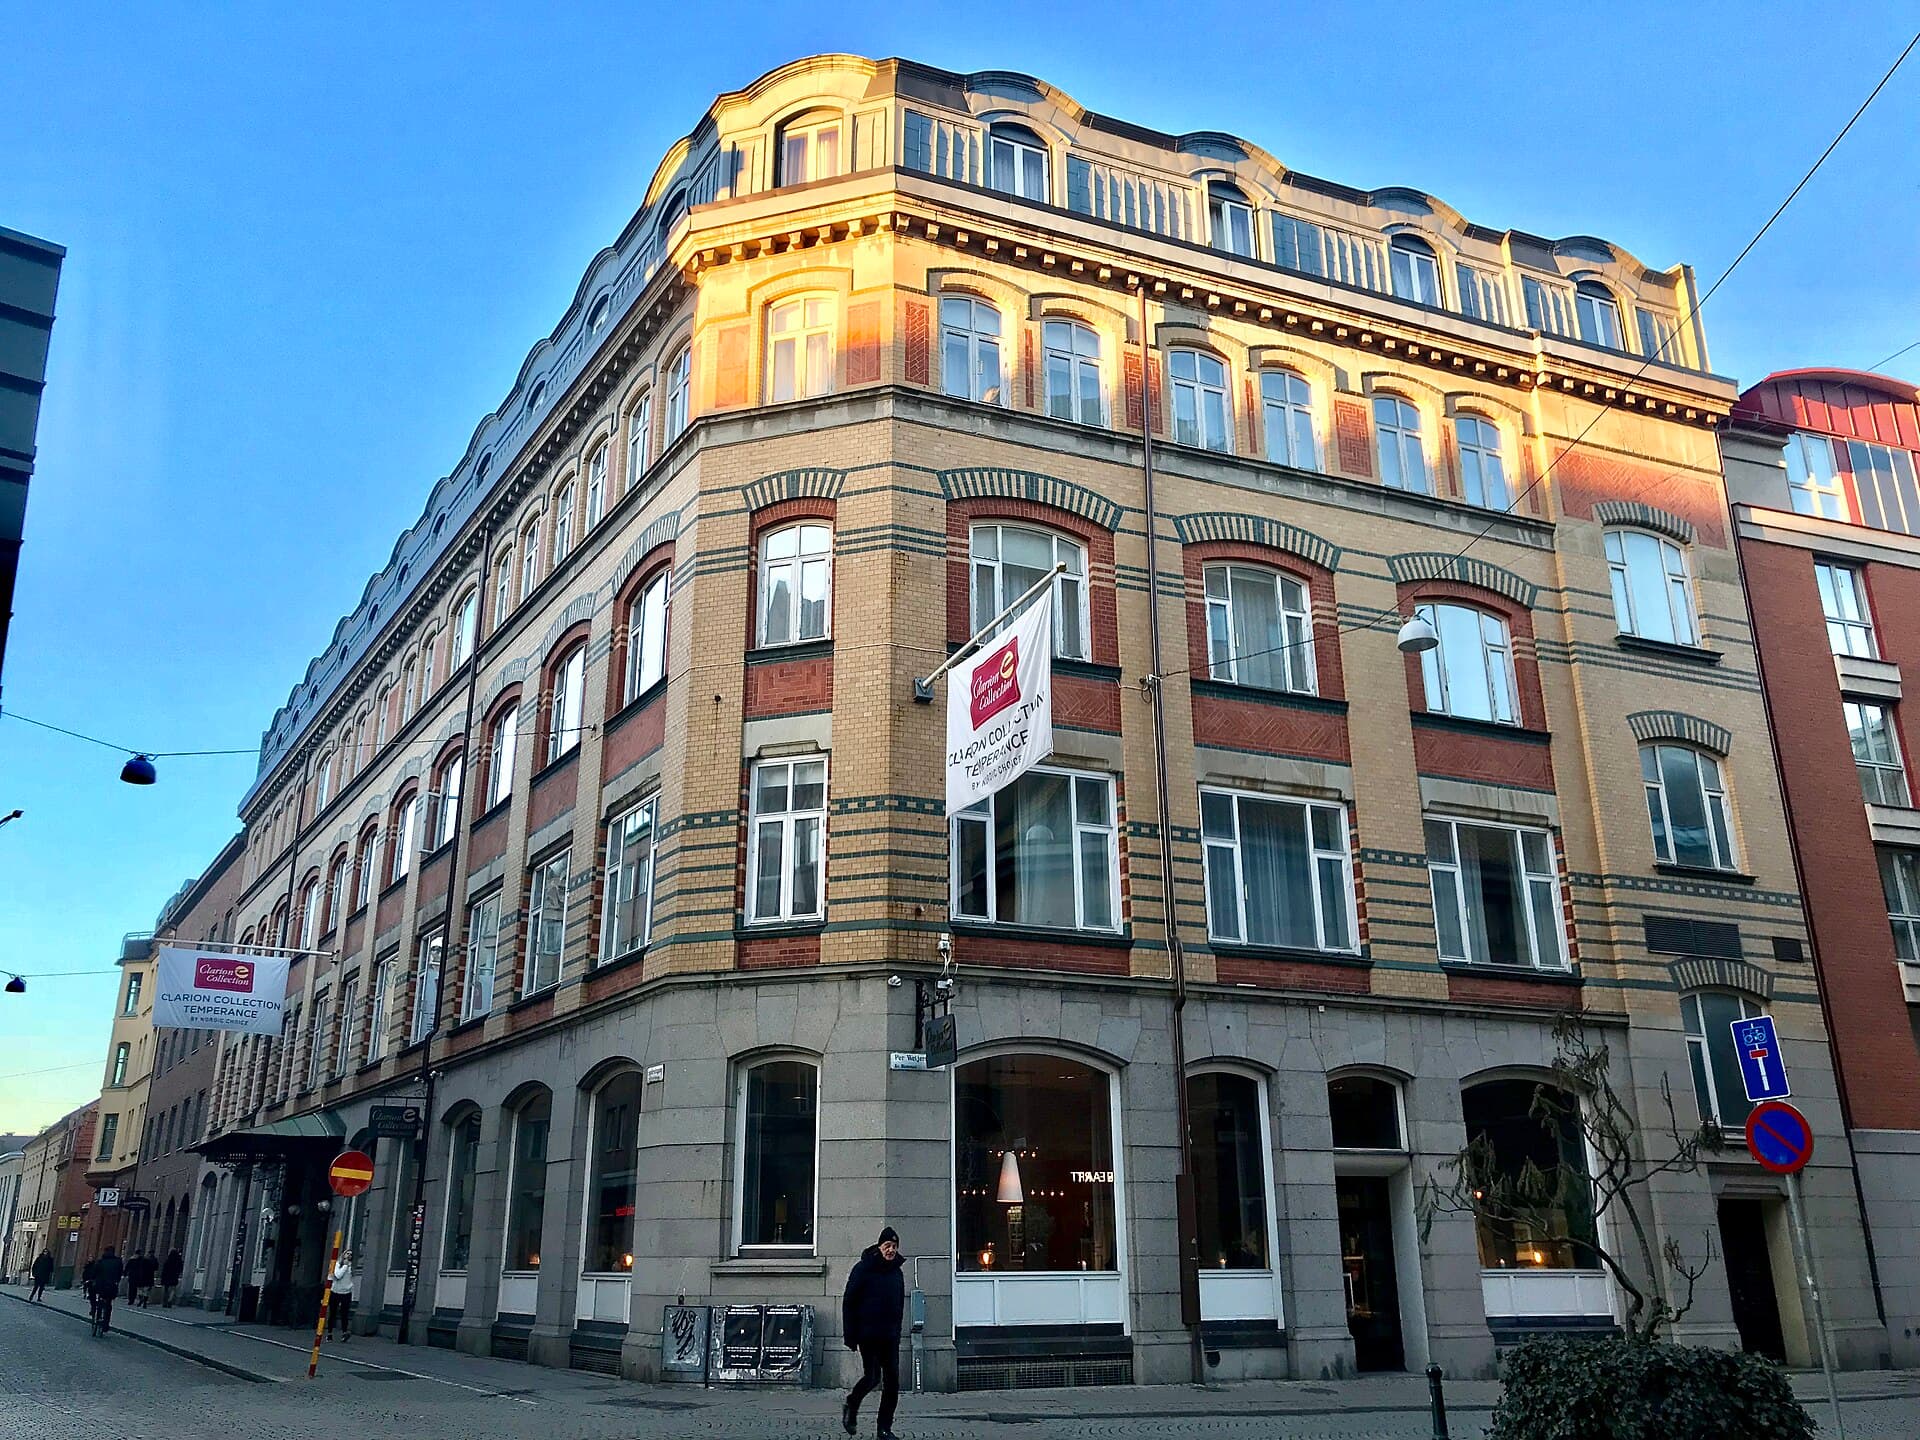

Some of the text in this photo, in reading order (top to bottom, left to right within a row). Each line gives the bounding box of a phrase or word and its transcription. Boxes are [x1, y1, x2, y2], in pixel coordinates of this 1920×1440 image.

[973, 671, 1000, 699] Clarion
[979, 677, 1014, 711] Collection
[199, 963, 234, 976] Clarion
[206, 974, 249, 986] Collection
[161, 993, 281, 1010] CLARION COLLECTION
[183, 1005, 259, 1019] TEMPERANCE
[103, 1191, 117, 1202] 12
